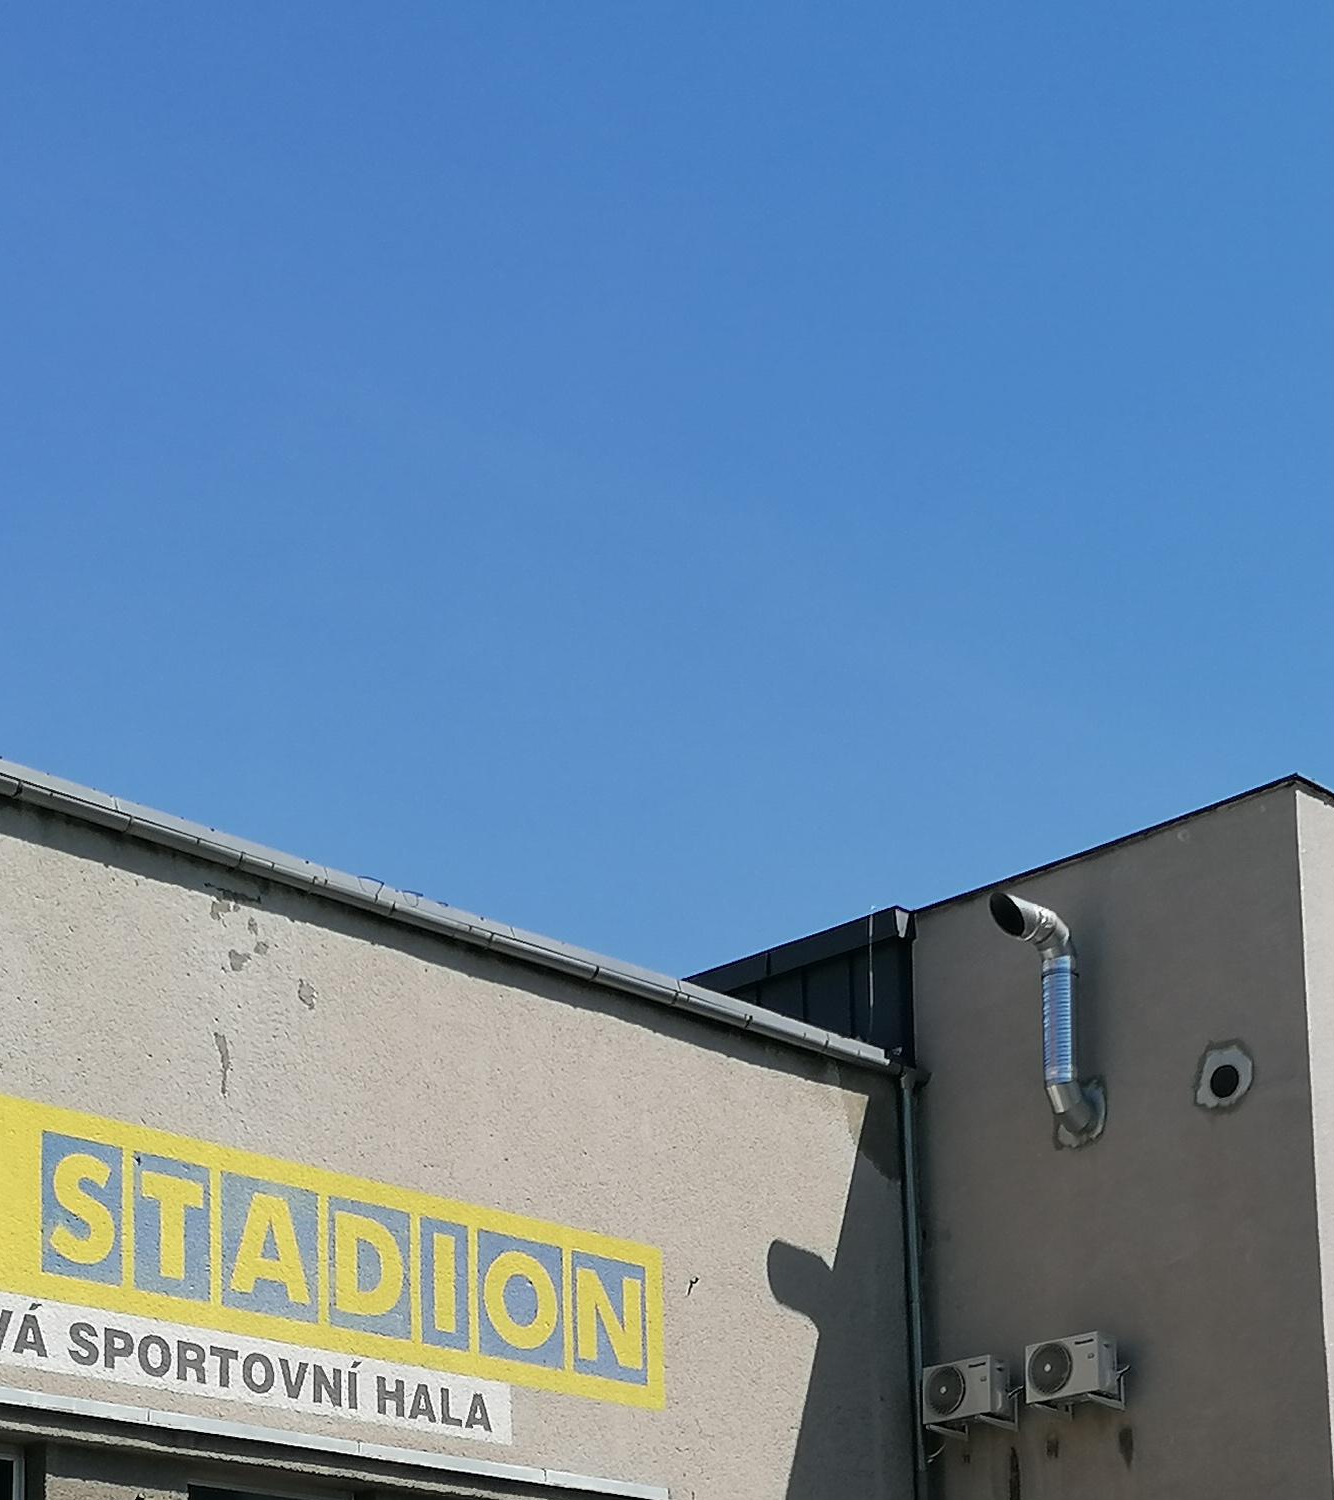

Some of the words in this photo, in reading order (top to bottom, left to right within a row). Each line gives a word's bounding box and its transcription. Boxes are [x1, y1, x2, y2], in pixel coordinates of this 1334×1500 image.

[49, 1153, 643, 1370] STADION
[68, 1321, 362, 1410] SPORTOVNÍ
[377, 1375, 493, 1432] HALA
